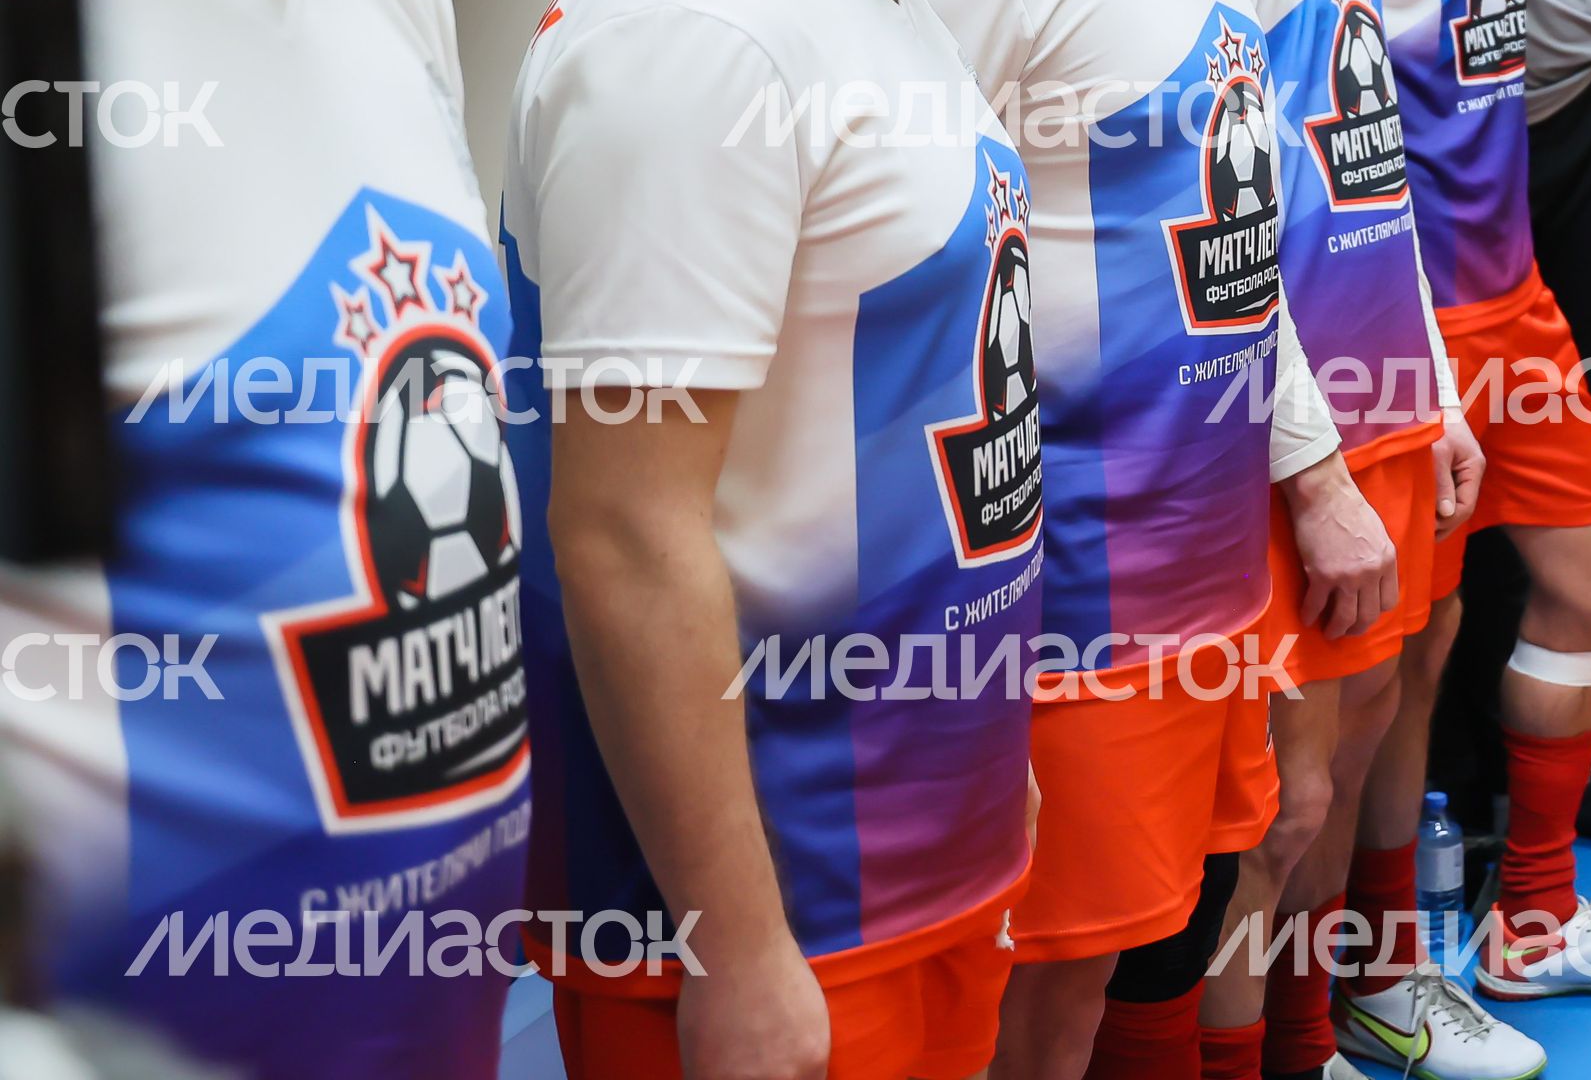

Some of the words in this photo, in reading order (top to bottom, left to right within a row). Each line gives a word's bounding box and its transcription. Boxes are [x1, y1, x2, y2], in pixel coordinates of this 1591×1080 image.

[1330, 121, 1384, 167] МАТЧ
[1341, 158, 1395, 187] ФУТБОЛА
[1198, 226, 1255, 280] МАТЧ
[1327, 236, 1339, 254] С
[1340, 217, 1401, 252] ЖИТЕЛЯМИ
[1206, 272, 1264, 304] ФУТБОЛА
[1179, 365, 1191, 386] С
[1194, 343, 1255, 384] ЖИТЕЛЯМИ
[972, 420, 1026, 498] МАТЧ
[981, 474, 1033, 527] ФУТБОЛА
[945, 605, 960, 632] С
[964, 564, 1031, 628] ЖИТЕЛЯМИ
[348, 606, 481, 725] МАТЧ
